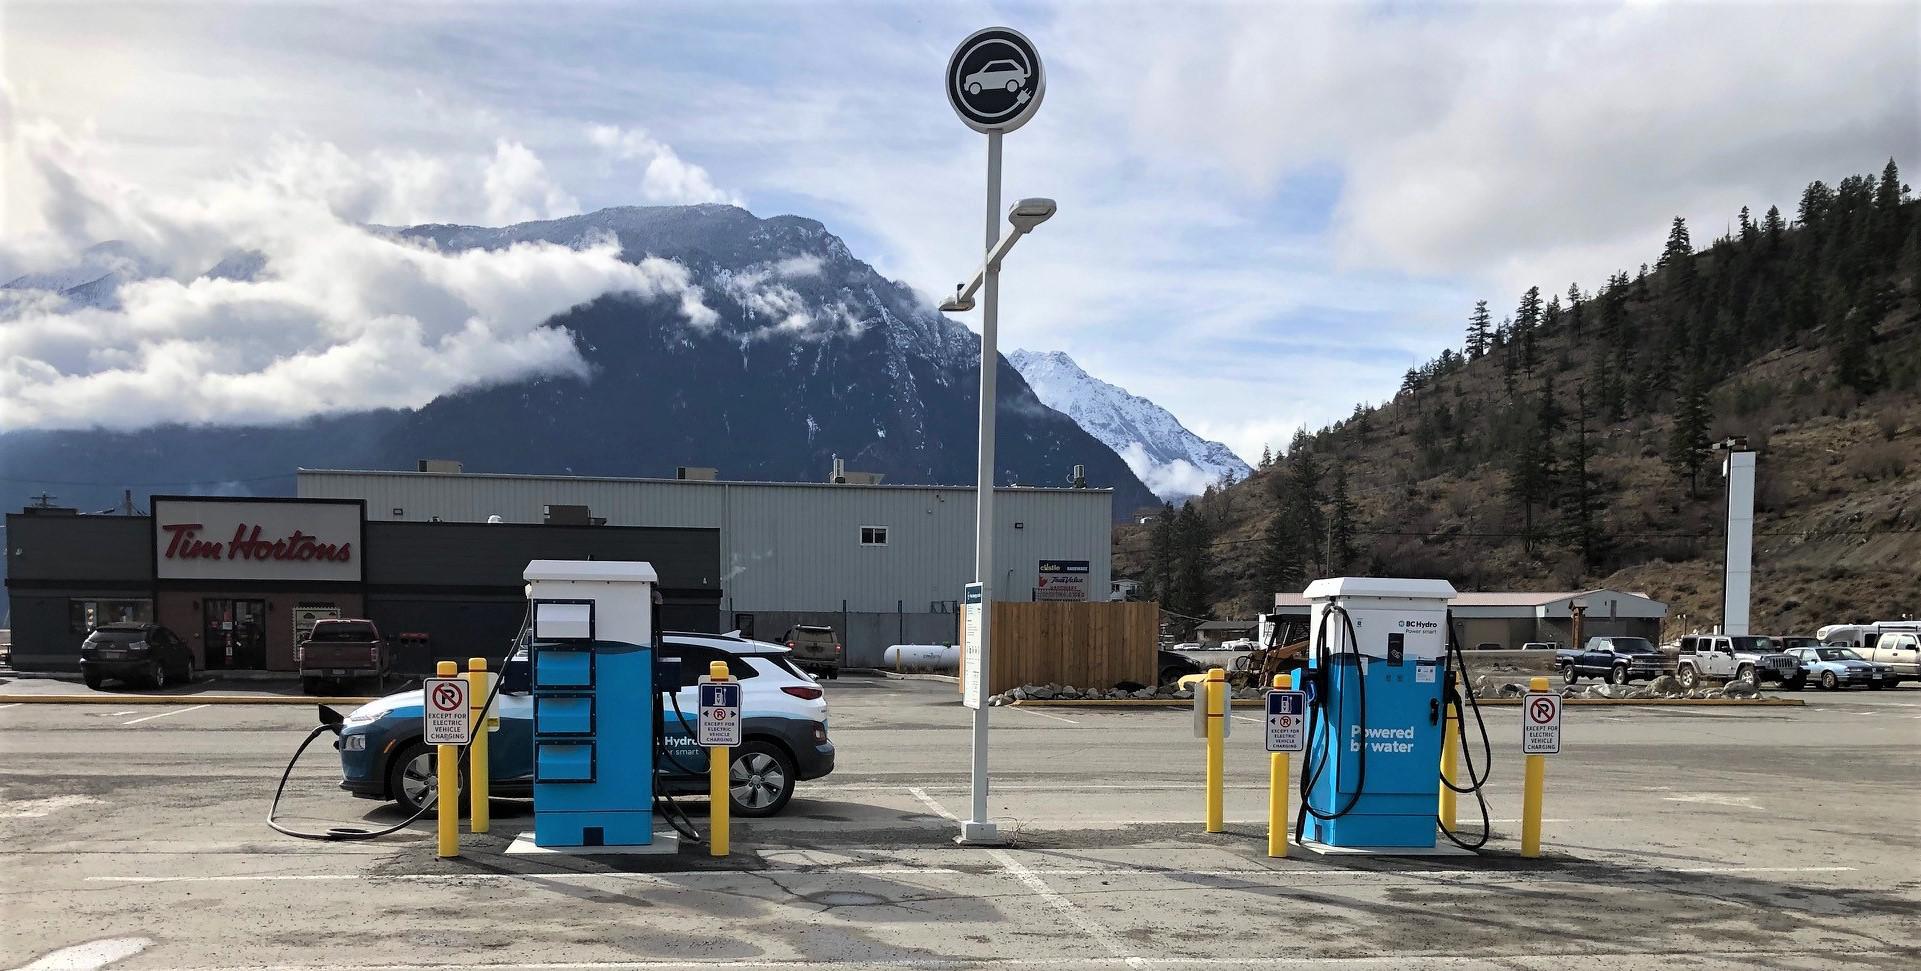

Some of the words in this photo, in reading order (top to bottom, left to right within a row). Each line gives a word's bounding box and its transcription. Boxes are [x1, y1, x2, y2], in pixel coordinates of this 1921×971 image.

[162, 523, 223, 560] Tim
[228, 523, 351, 562] Hortons
[1405, 620, 1416, 628] BC
[1416, 620, 1438, 629] Hydro
[664, 735, 698, 748] Hydro
[1350, 739, 1368, 753] b
[1371, 741, 1415, 753] water
